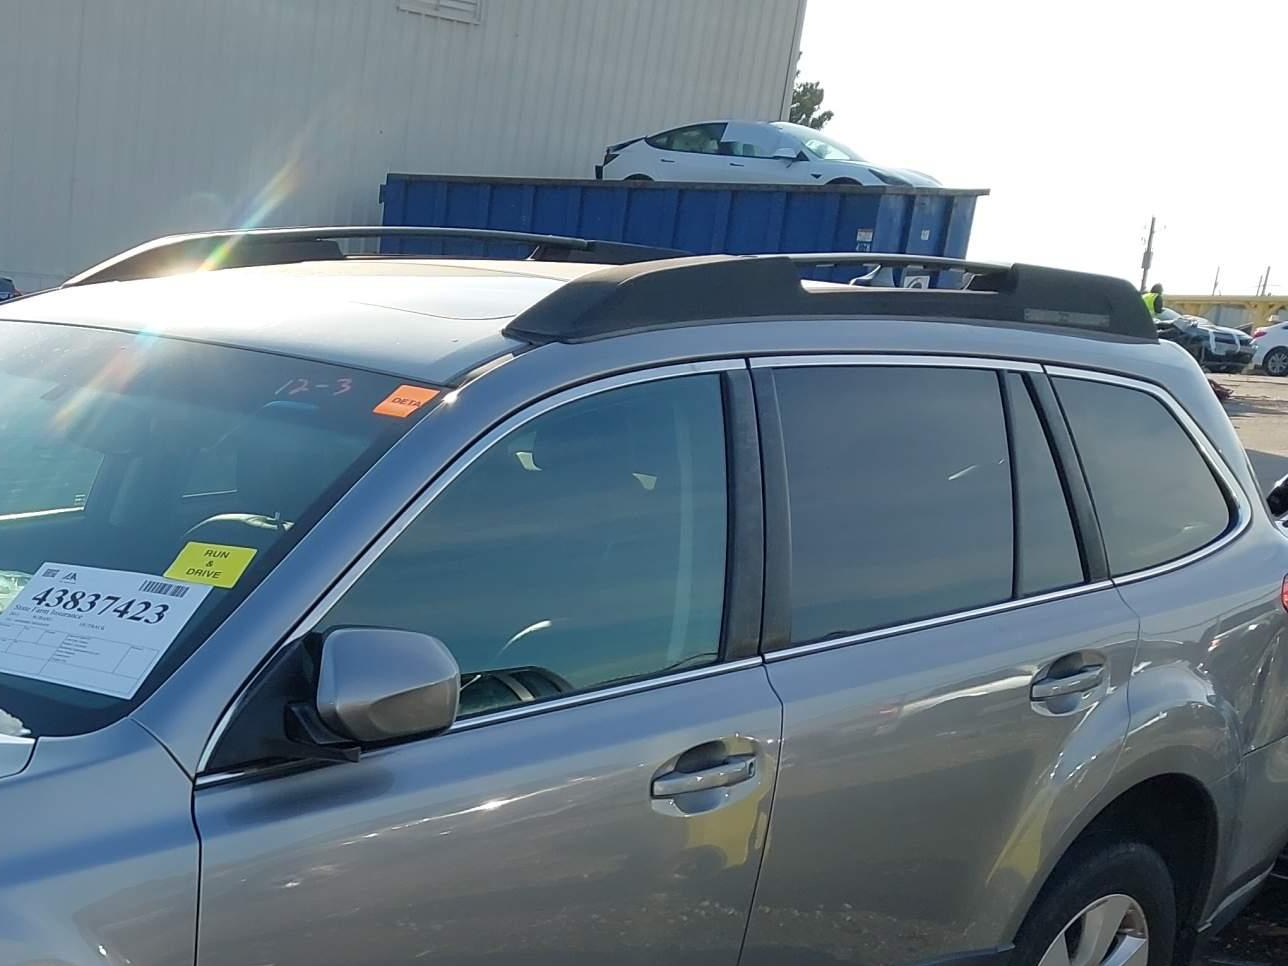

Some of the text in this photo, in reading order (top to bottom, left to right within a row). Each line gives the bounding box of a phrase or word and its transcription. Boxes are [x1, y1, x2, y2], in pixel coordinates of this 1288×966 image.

[203, 549, 231, 559] RUN
[185, 567, 223, 579] DRIVE
[31, 586, 170, 625] 43837423
